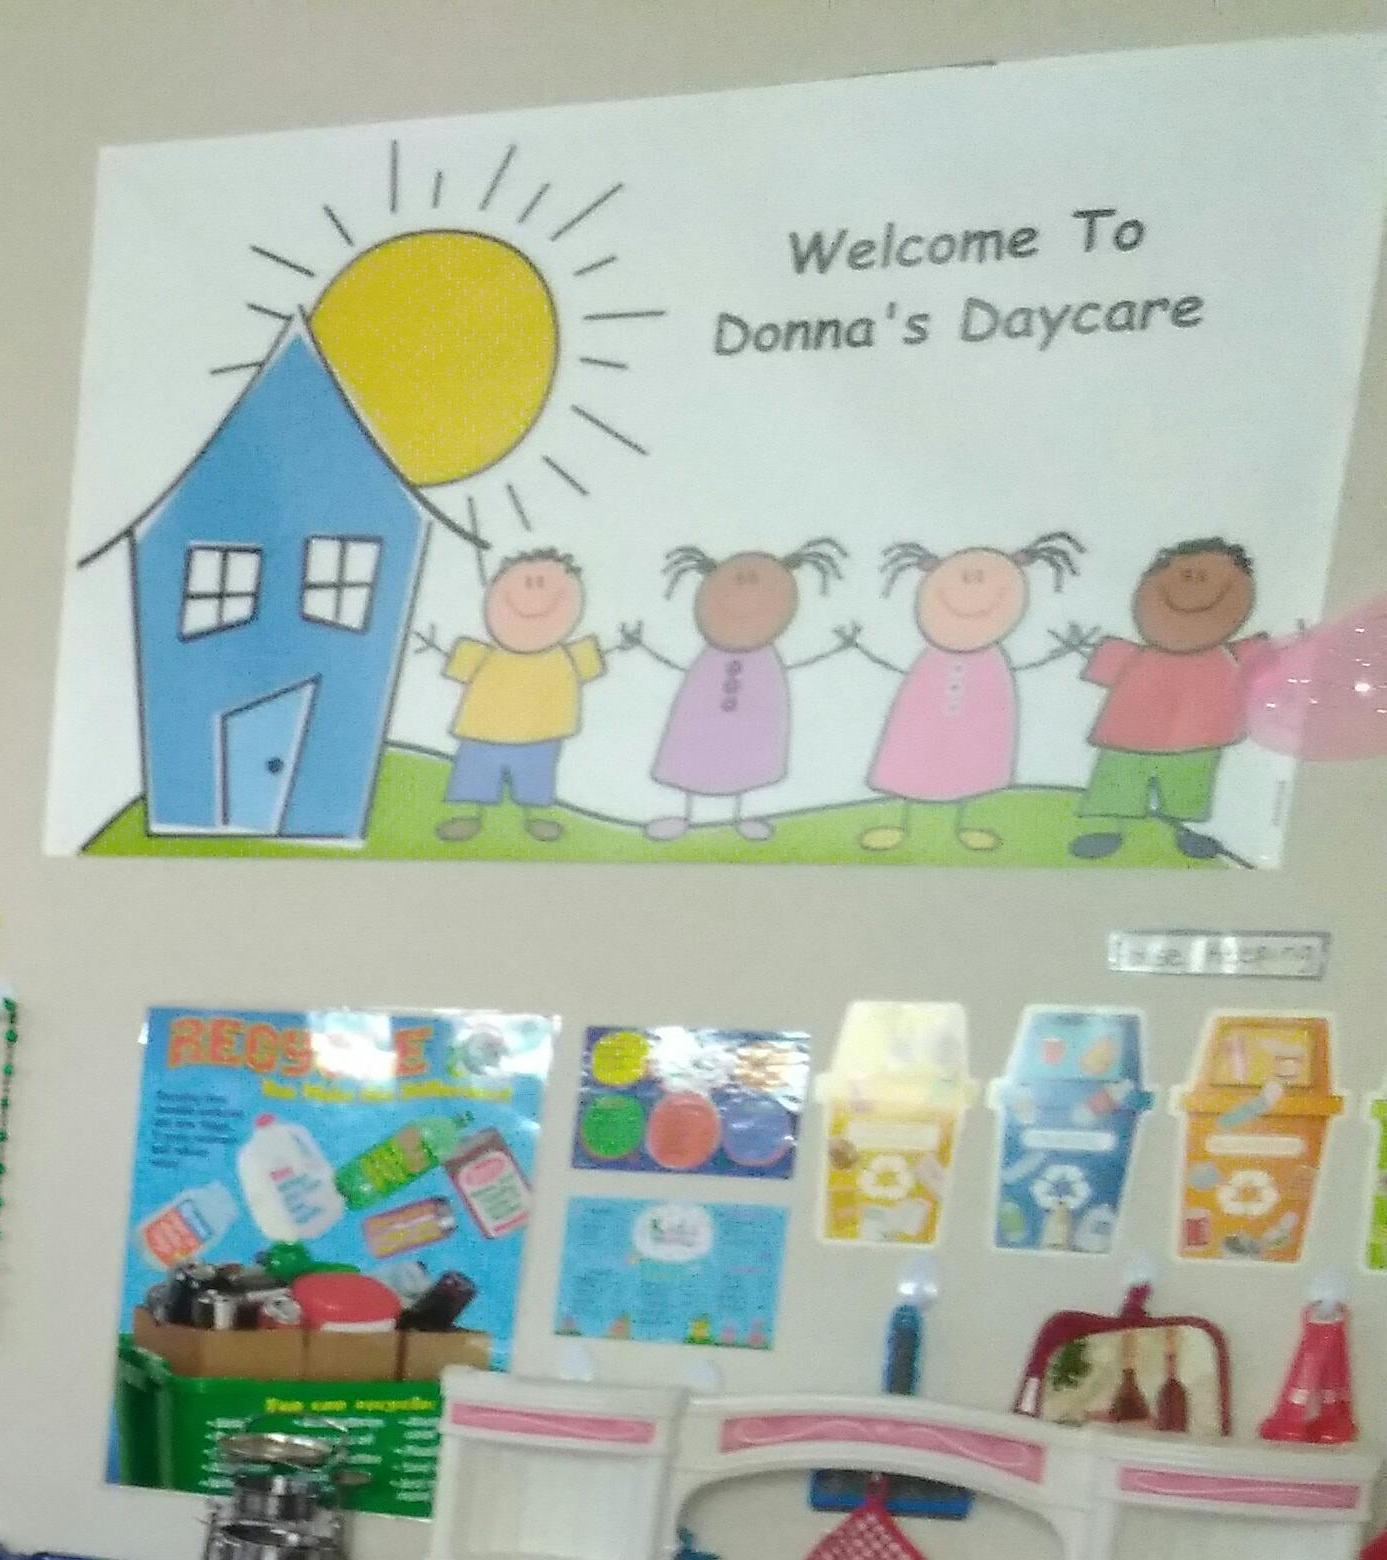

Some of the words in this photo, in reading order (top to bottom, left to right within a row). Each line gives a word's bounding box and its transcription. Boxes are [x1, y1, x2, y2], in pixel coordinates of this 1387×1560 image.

[788, 220, 1039, 275] Welcome
[1072, 208, 1145, 253] To
[714, 300, 931, 355] Donna's
[961, 295, 1205, 351] Daycare
[167, 1014, 434, 1082] RECYE
